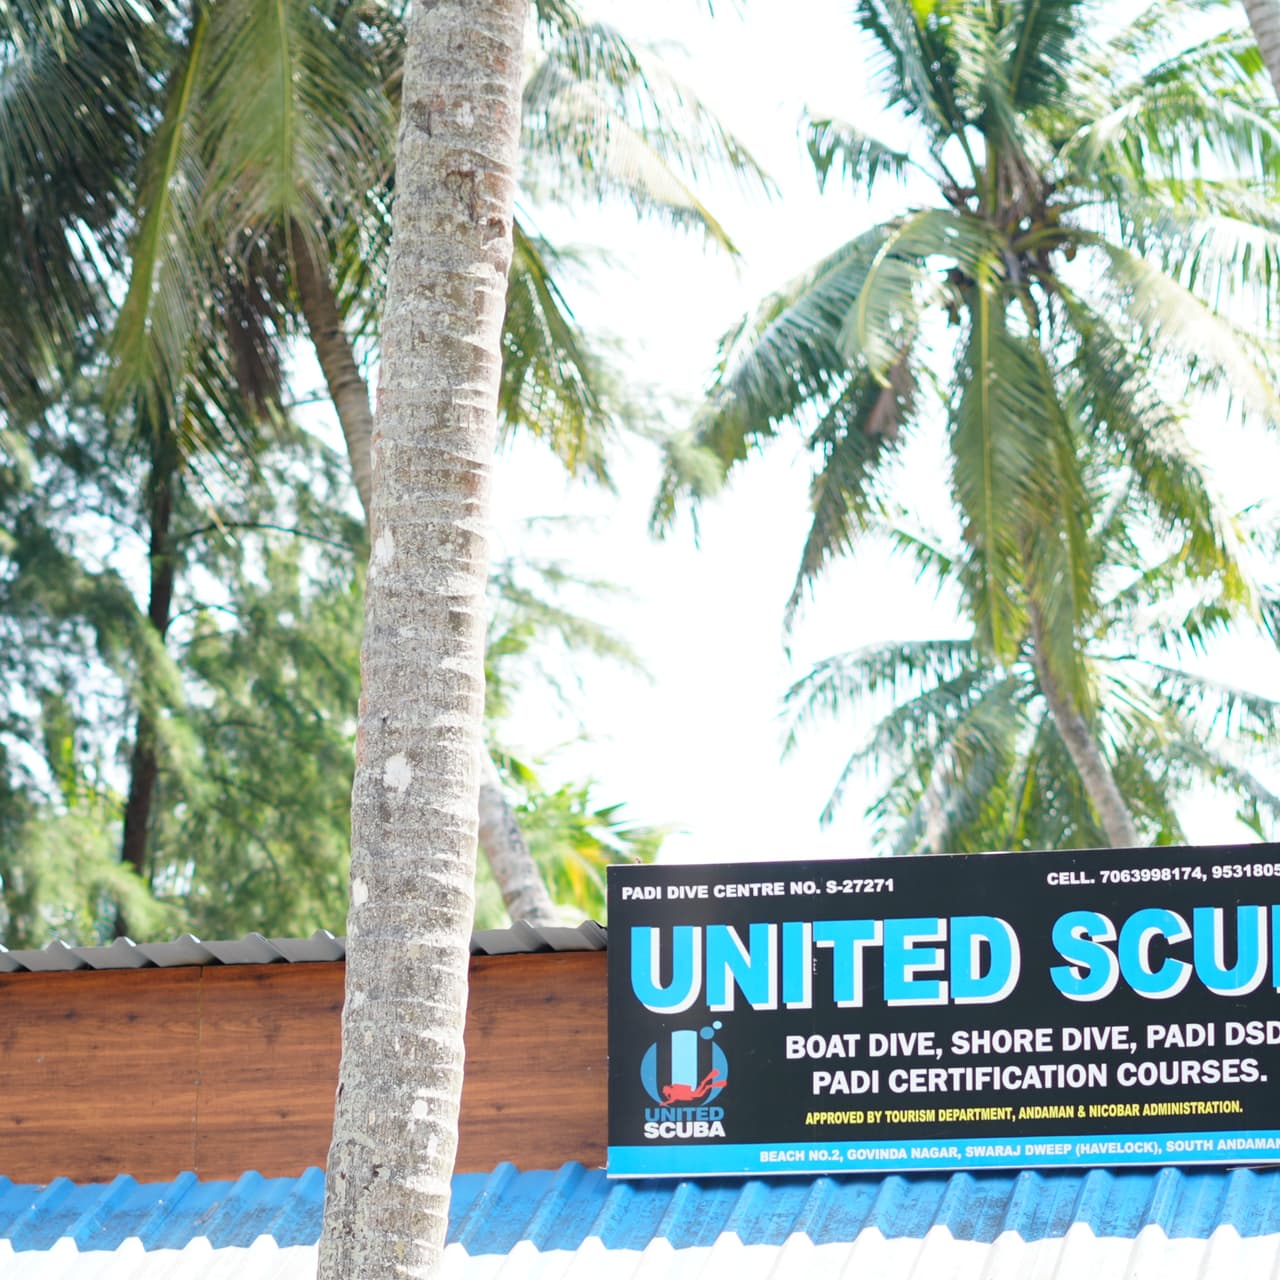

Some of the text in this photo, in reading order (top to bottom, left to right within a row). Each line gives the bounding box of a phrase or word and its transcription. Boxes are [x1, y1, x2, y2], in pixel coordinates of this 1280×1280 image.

[1047, 870, 1096, 886] CELL.
[1100, 865, 1208, 884] 7063998174,
[622, 878, 895, 900] PADI DIVE CENTRE NO. S-27271
[630, 915, 1021, 1014] UNITED
[785, 1033, 861, 1059] BOAT
[868, 1030, 943, 1060] DIVE,
[950, 1028, 1054, 1055] SHORE
[1062, 1025, 1138, 1054] DIVE,
[1146, 1023, 1216, 1049] PADI
[812, 1058, 1268, 1095] PADI CERTIFICATION COURSES.
[644, 1106, 725, 1122] UNITED
[805, 1100, 1244, 1126] APPROVED BY TOURISM DEPARTMENT, ANDAMAN & NICOBAR ADMINISTRATION.
[643, 1121, 726, 1139] SCUBA
[760, 1150, 805, 1163] BEACH
[809, 1149, 844, 1163] NO.2,
[847, 1148, 908, 1161] GOVINDA
[911, 1146, 962, 1160] NAGAR,
[965, 1144, 1022, 1158] SWARAJ
[1025, 1143, 1072, 1156] DWEEP
[1076, 1141, 1162, 1157] (HAVELOCK),
[1166, 1139, 1213, 1152] SOUTH
